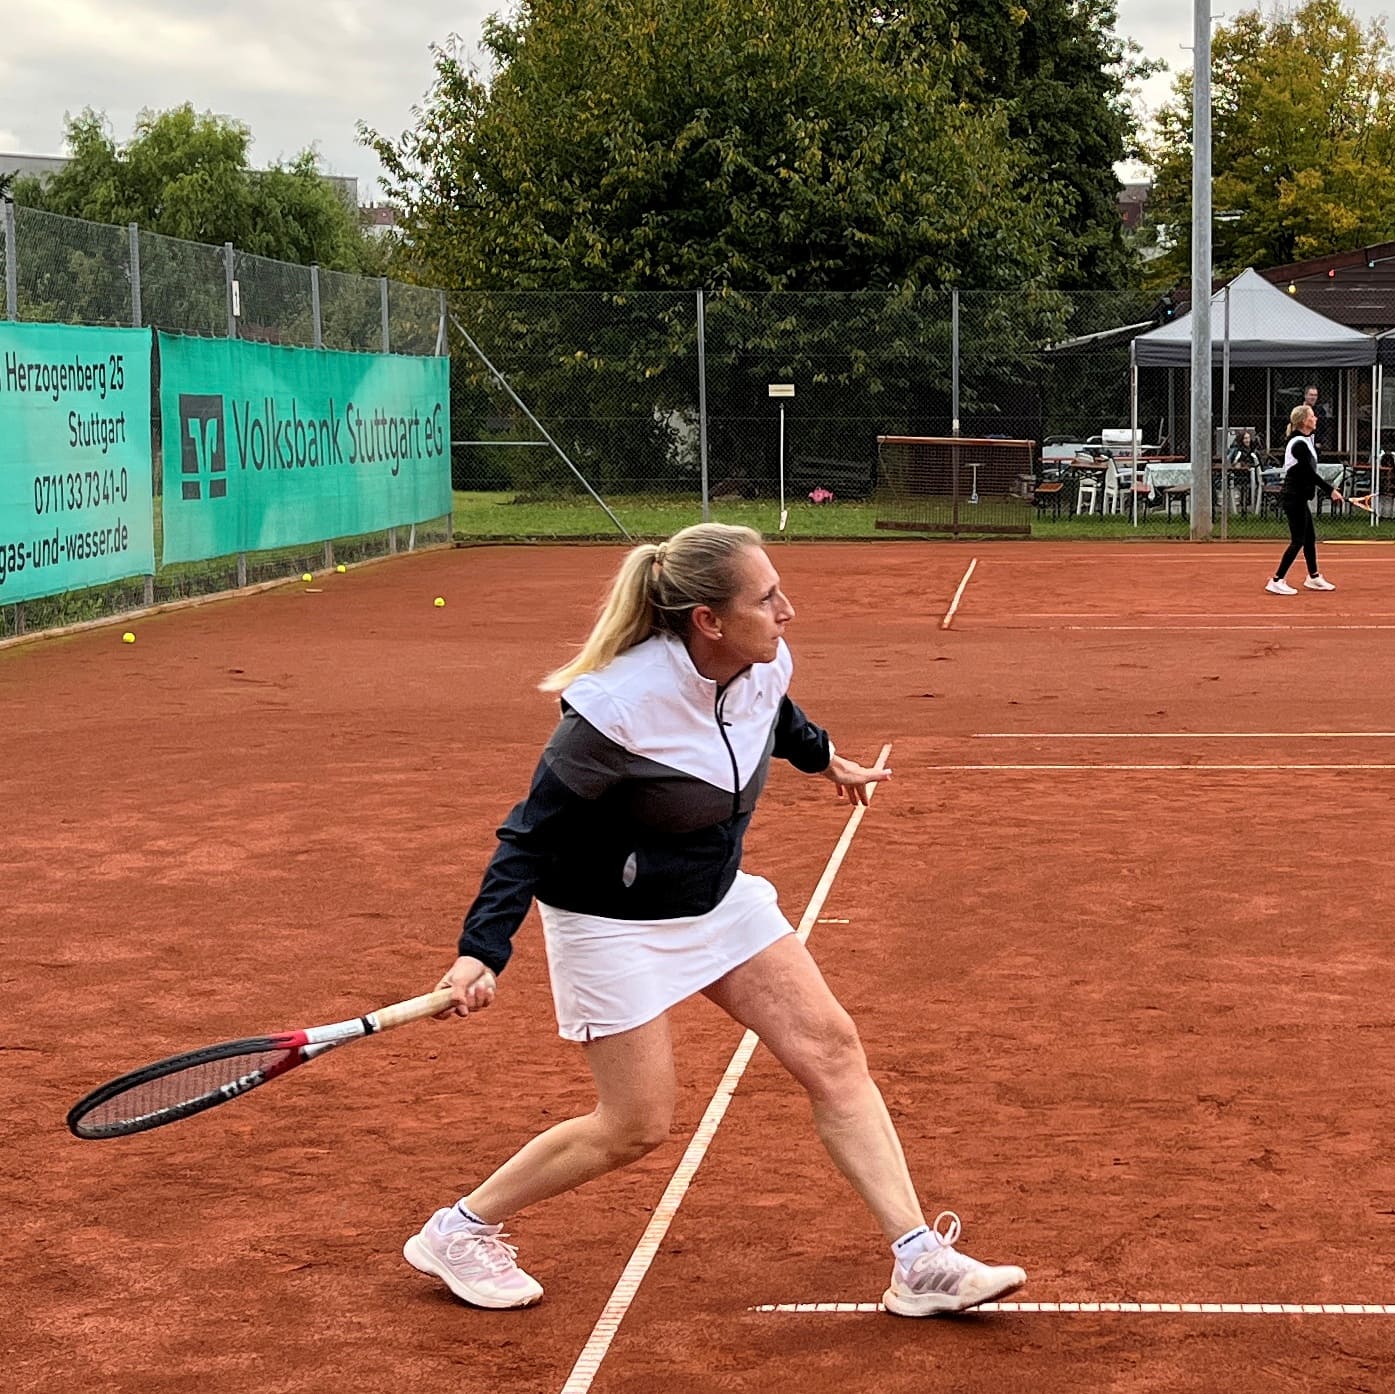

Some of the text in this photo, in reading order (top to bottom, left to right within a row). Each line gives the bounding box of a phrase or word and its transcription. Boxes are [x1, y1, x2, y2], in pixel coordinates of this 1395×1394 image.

[5, 351, 124, 401] Herzogenberg 25
[68, 411, 125, 454] Stuttgart
[232, 397, 443, 476] Volksbank Stuttgart eG
[0, 517, 128, 585] gas-und-wasser.de
